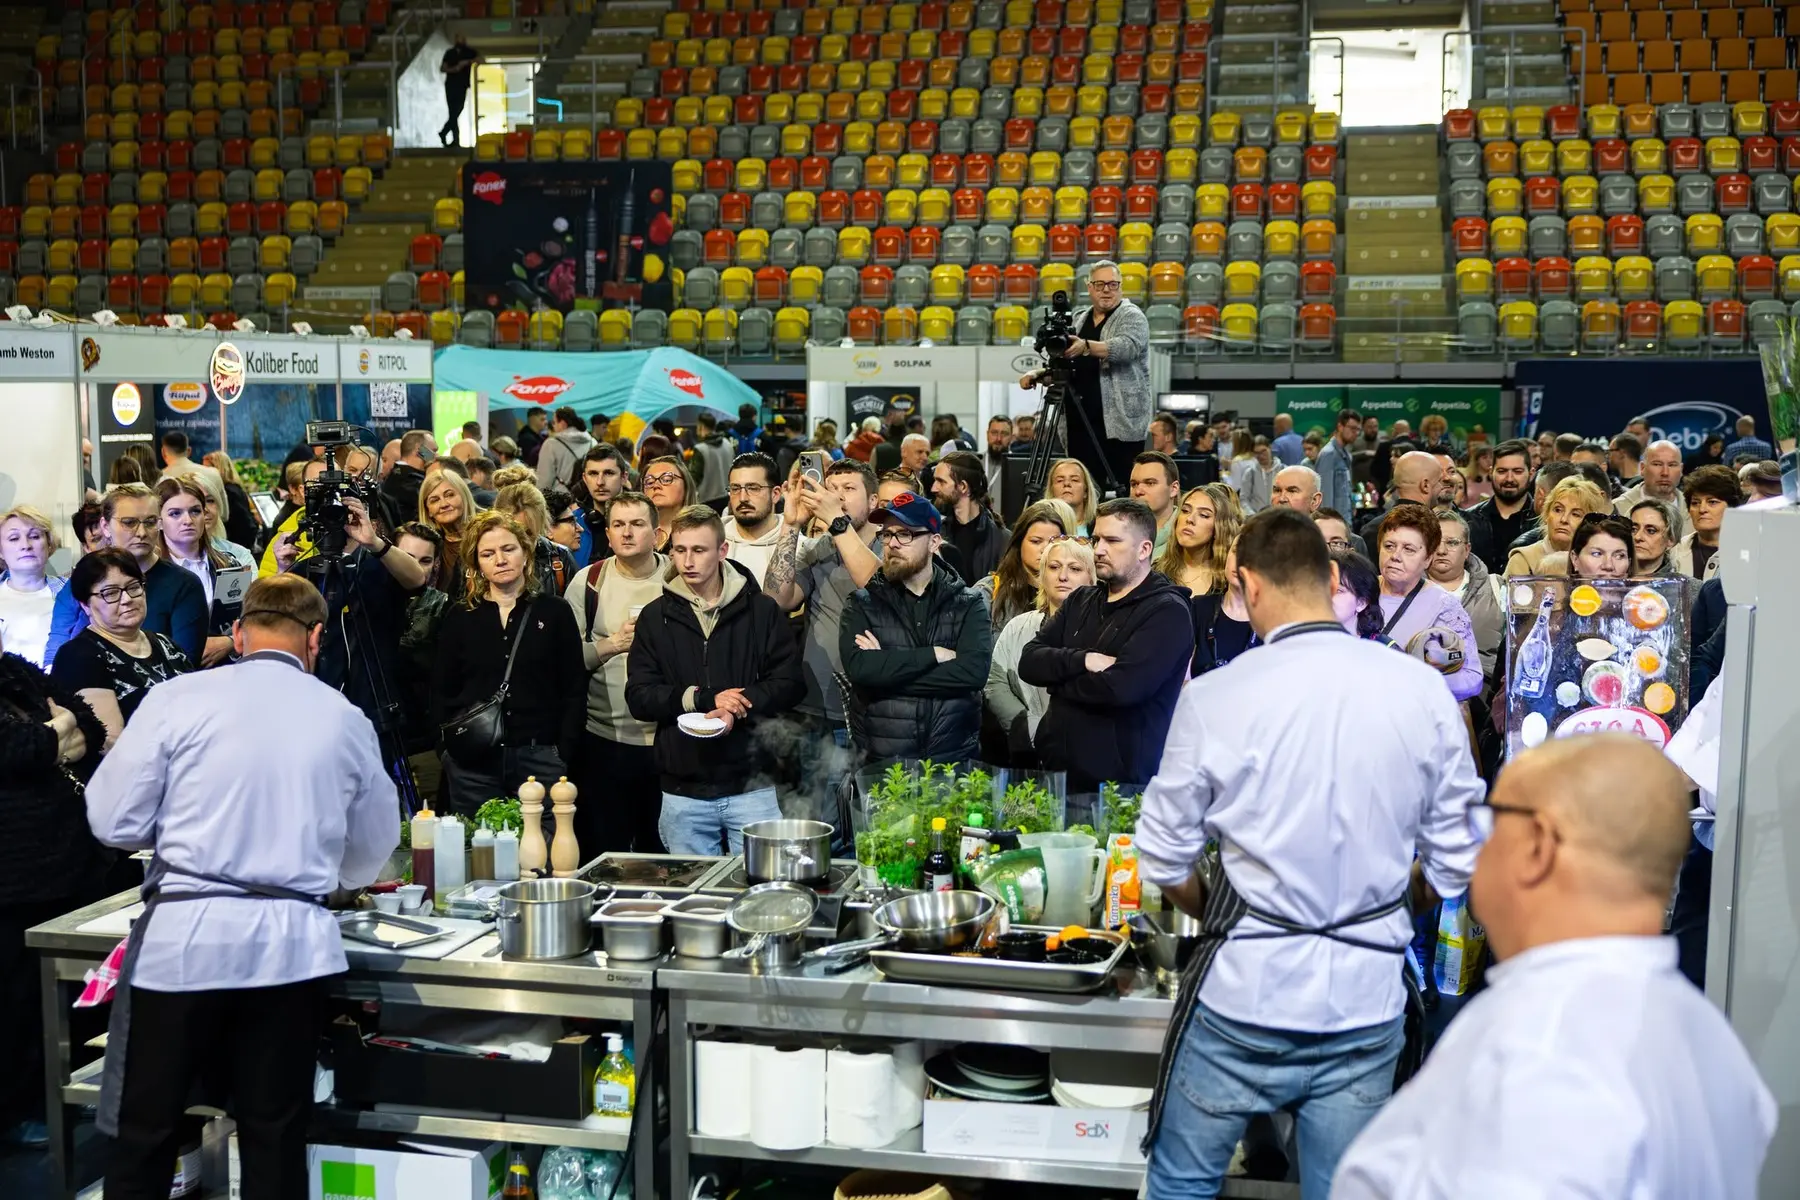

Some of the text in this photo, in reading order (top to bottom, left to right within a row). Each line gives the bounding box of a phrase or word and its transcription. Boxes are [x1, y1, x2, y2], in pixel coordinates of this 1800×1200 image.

[473, 179, 507, 194] Fanex
[20, 347, 55, 359] Weston
[246, 351, 319, 374] Koliber Food
[378, 355, 407, 371] RITPOL
[893, 359, 932, 368] SOLPAK
[670, 375, 702, 387] Fanex
[504, 382, 573, 395] Fanex
[1288, 400, 1328, 410] Appetito
[1361, 400, 1404, 410] Appetito
[1430, 401, 1471, 410] Appetito
[1648, 427, 1710, 450] Debi
